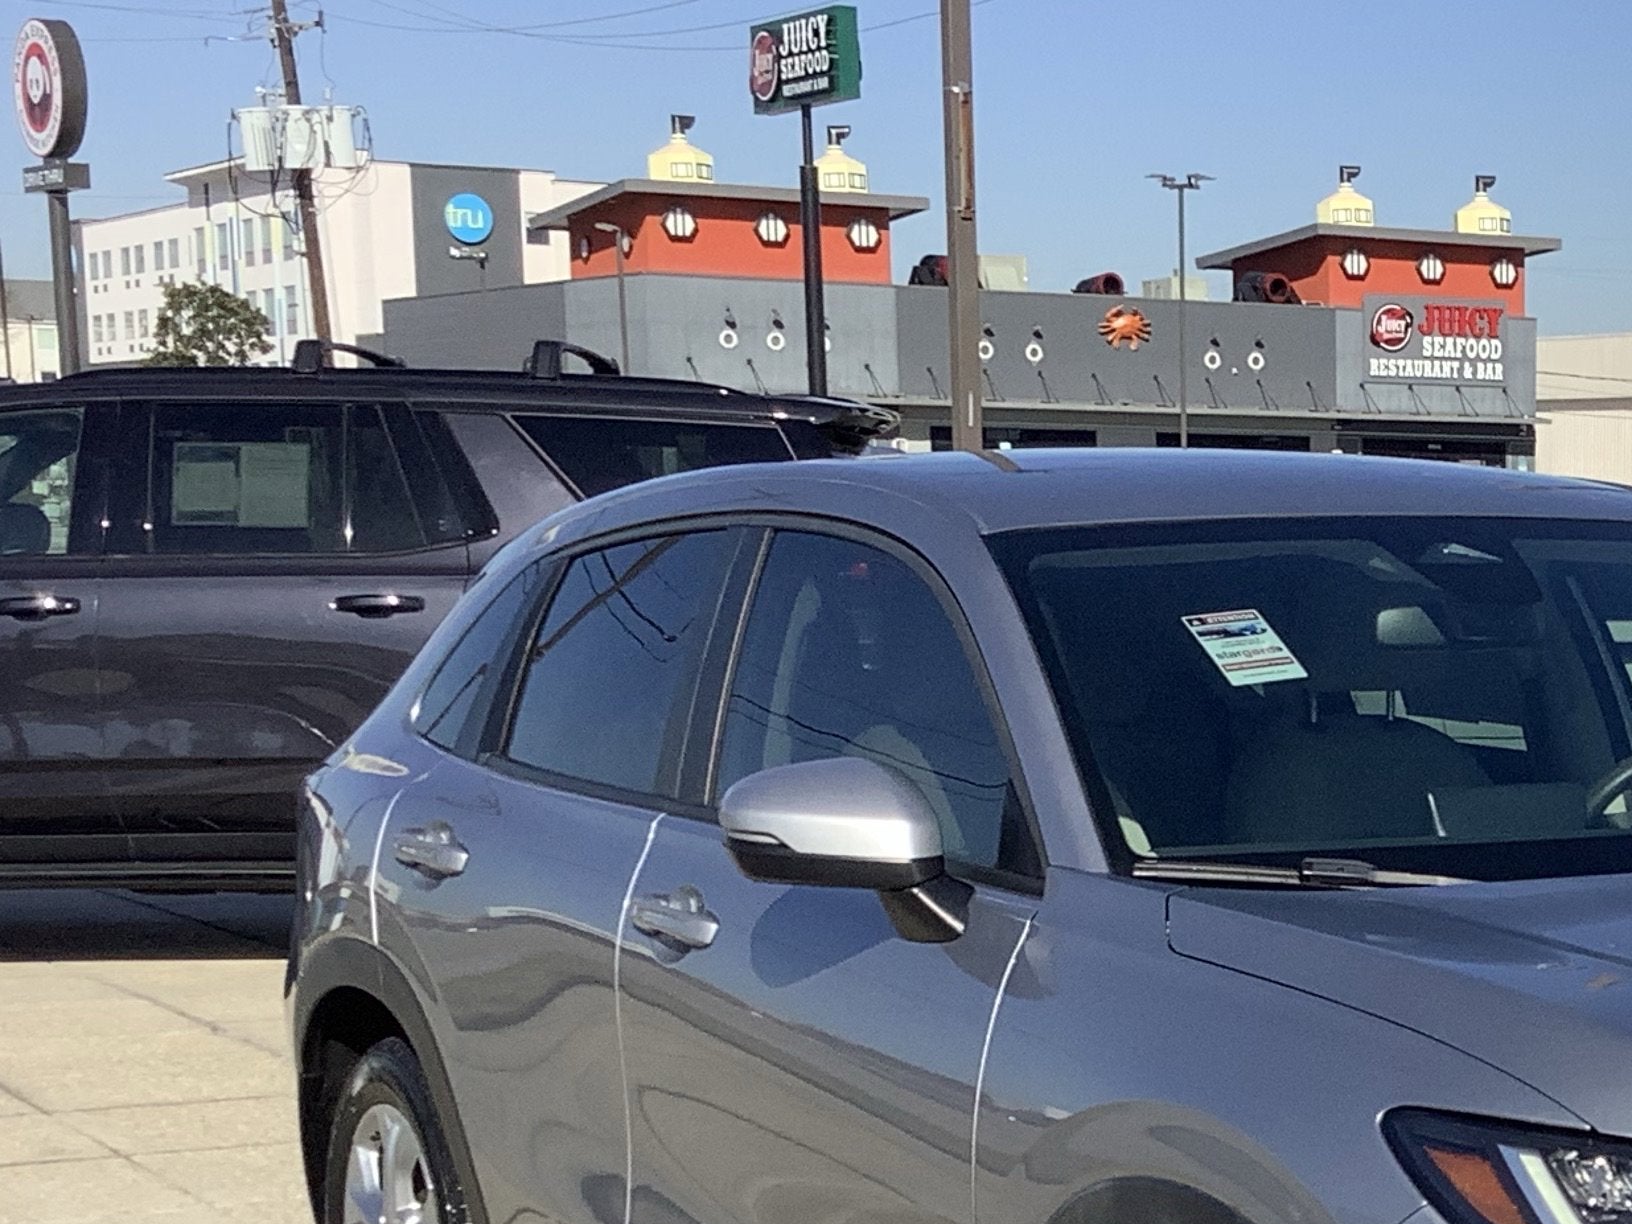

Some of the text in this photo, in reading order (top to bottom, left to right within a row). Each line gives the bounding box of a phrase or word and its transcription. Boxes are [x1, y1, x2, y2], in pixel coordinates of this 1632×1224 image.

[778, 14, 829, 57] JUICY
[780, 49, 830, 80] SEAFOOD
[445, 203, 485, 229] tru
[1418, 303, 1504, 338] JUICY
[1422, 336, 1503, 360] SEAFOOD
[1369, 358, 1504, 381] RESTAURANT & BAR
